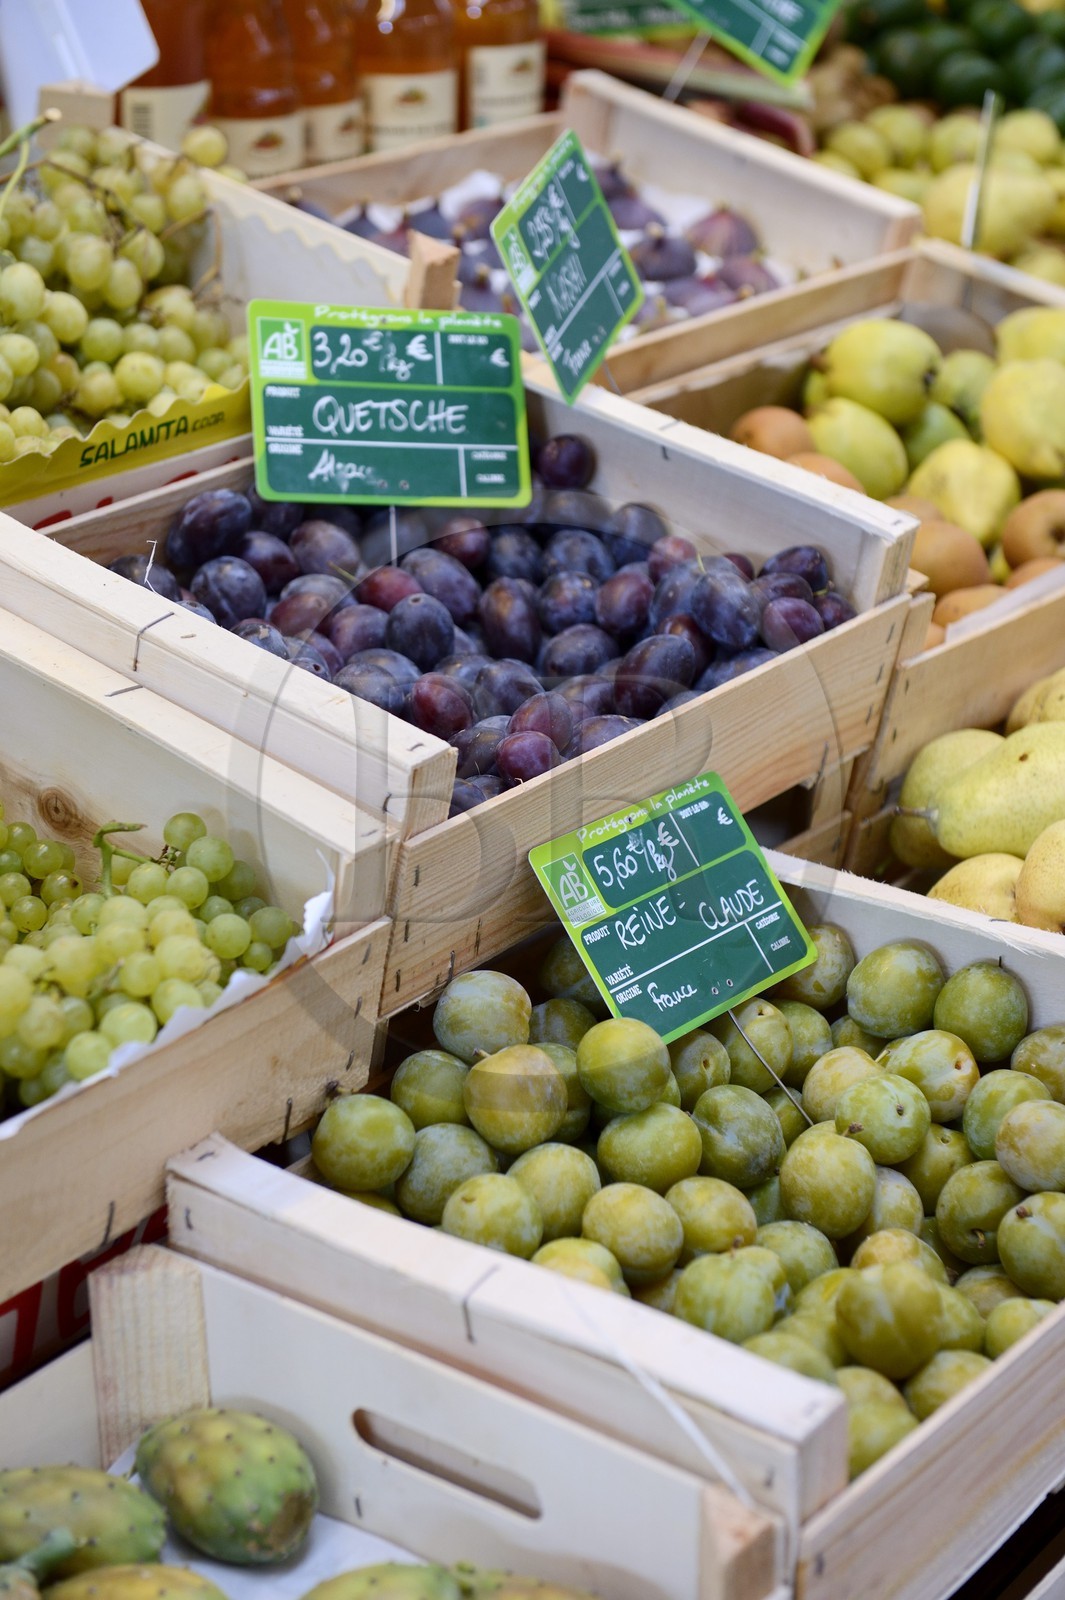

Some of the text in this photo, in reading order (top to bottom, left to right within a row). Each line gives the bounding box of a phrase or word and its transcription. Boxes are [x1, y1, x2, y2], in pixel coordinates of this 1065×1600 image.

[263, 331, 299, 360] AB
[405, 334, 434, 361] €
[489, 347, 511, 368] €
[312, 395, 469, 437] QUETSCHE
[79, 415, 189, 467] SALAMITA
[650, 797, 663, 810] la
[665, 780, 711, 809] planète
[717, 807, 733, 826] €
[657, 821, 680, 846] €
[559, 869, 589, 909] AB
[567, 898, 600, 918] AGRICULTURE
[698, 879, 764, 930] CLAUDE
[583, 925, 611, 945] PRODUIT
[605, 964, 634, 985] VARIÉTÉ
[616, 984, 643, 1005] ORIGINE
[647, 982, 698, 1011] France
